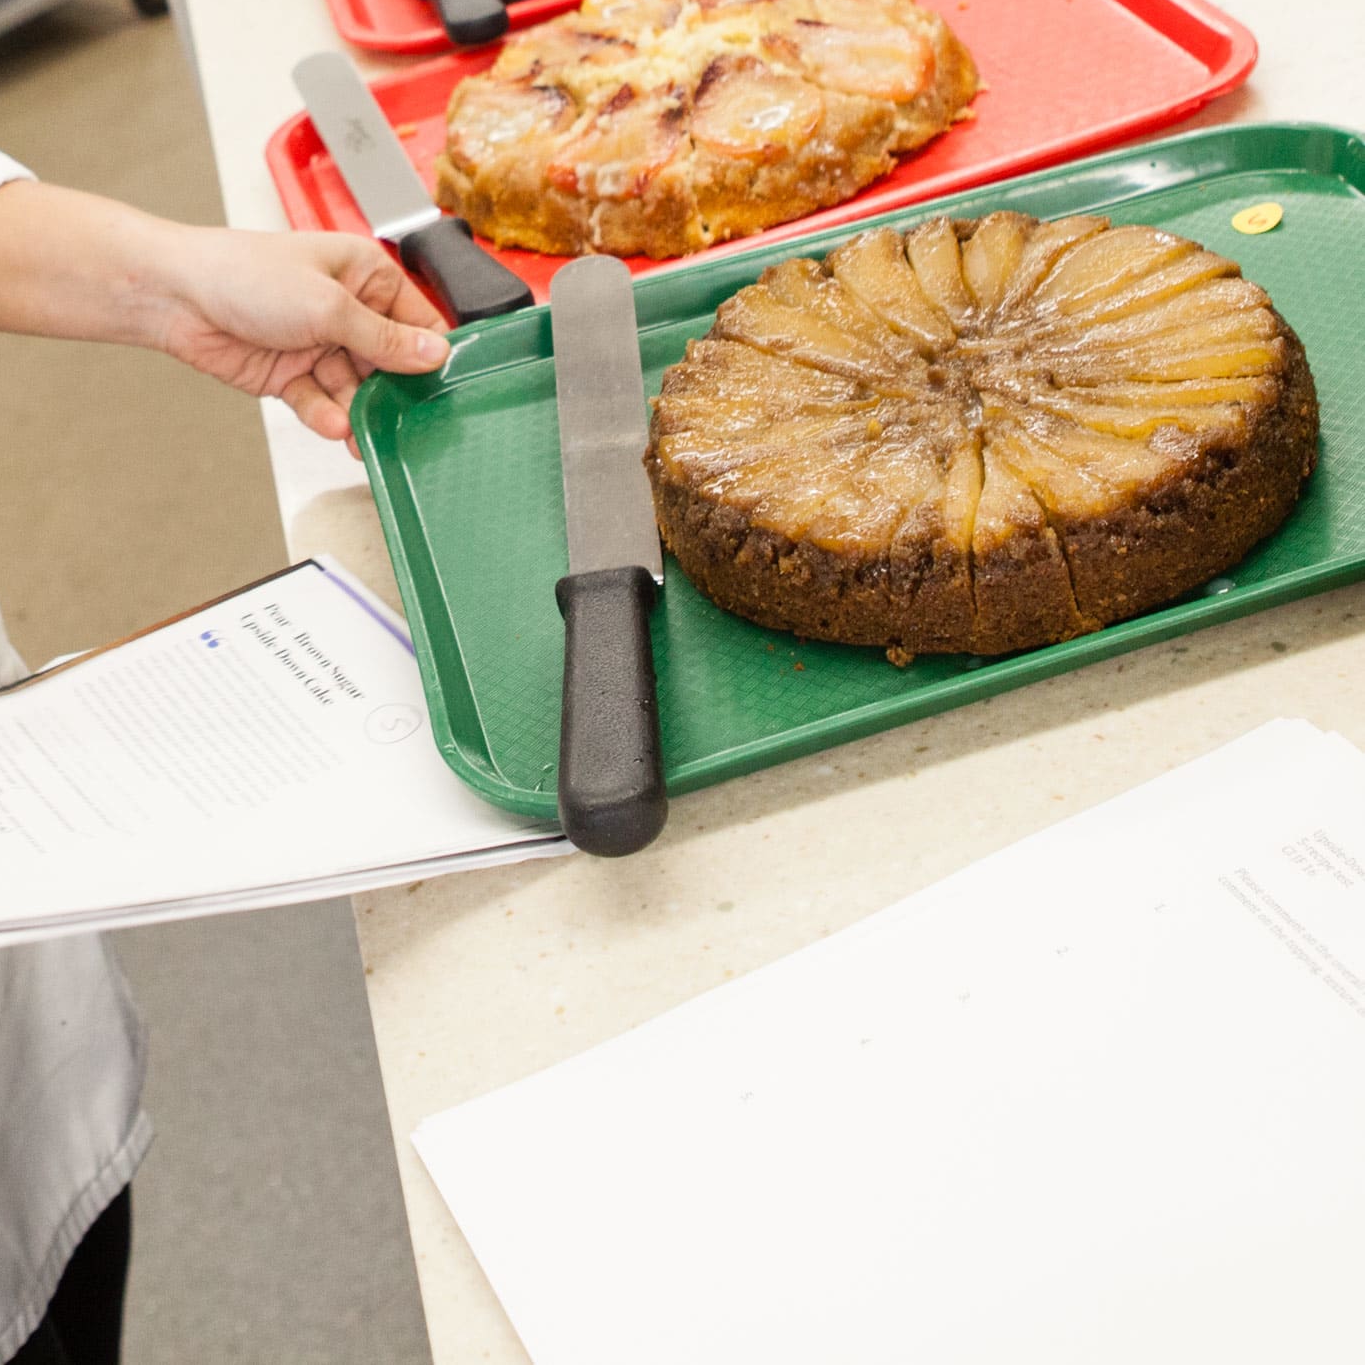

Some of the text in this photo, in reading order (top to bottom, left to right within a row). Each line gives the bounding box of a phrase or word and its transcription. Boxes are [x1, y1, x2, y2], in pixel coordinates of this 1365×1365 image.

[241, 613, 334, 704] Upside Down Cake
[332, 665, 365, 699] Sugar
